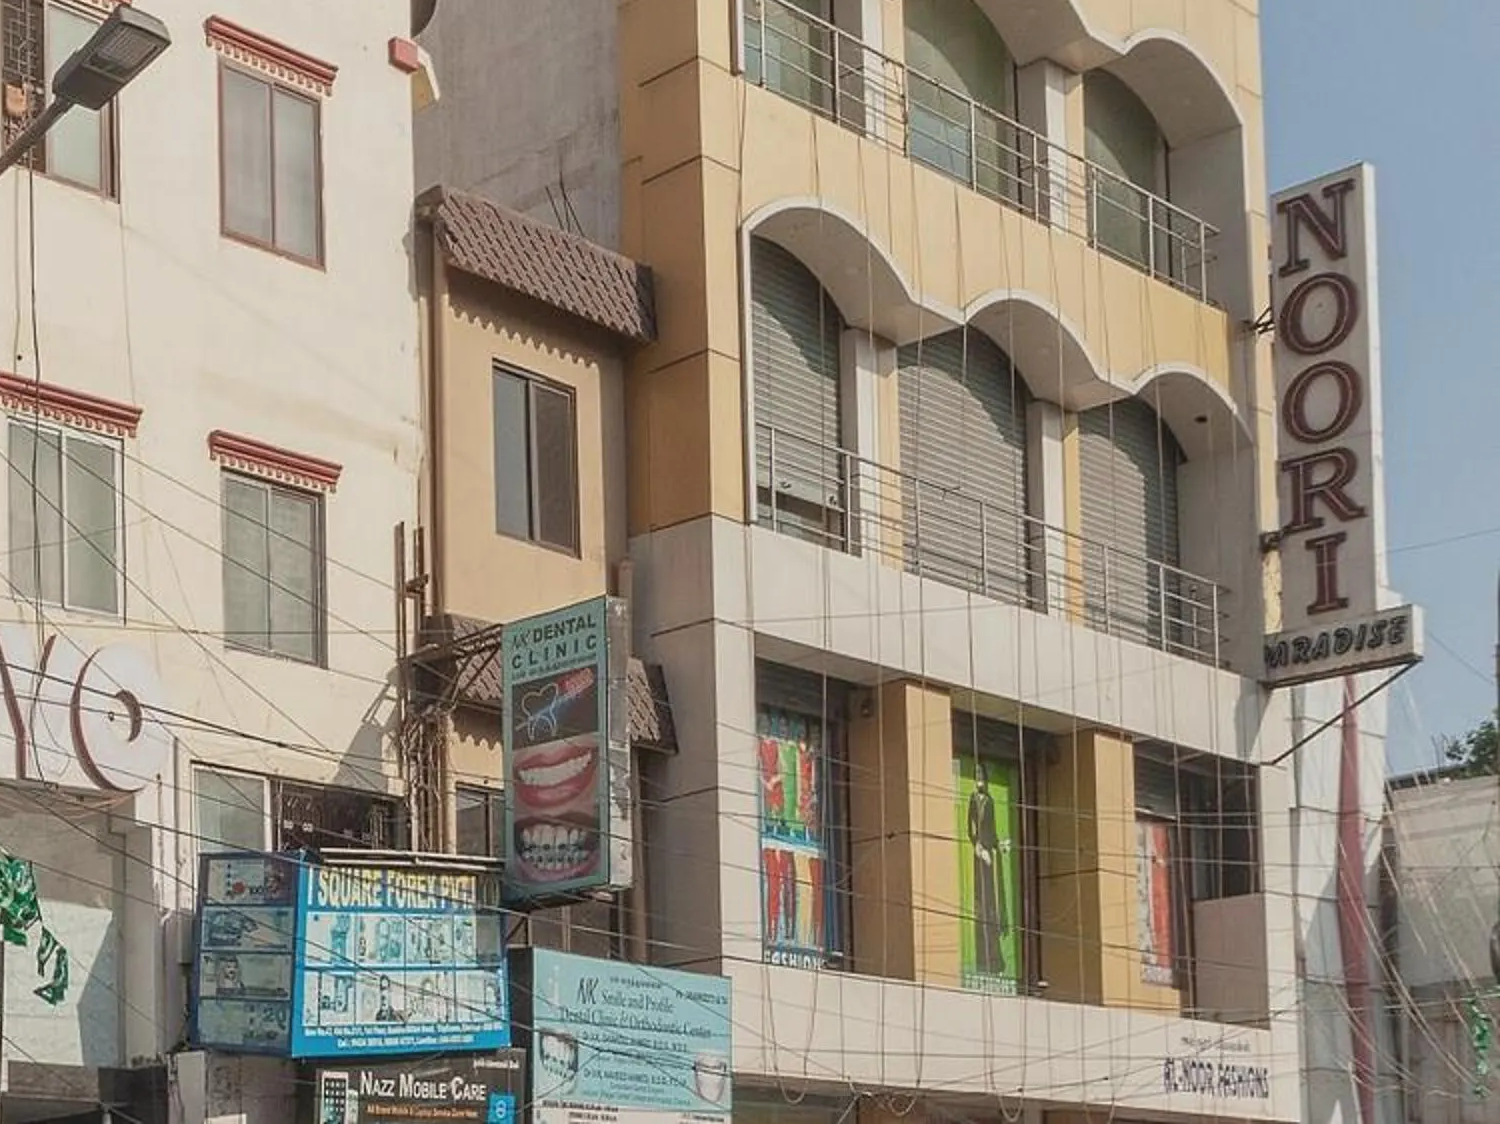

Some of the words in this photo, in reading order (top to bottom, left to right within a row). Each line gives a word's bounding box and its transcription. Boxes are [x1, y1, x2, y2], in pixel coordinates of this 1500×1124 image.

[1276, 178, 1369, 616] NOORI
[533, 612, 597, 644] DENTAL
[511, 634, 597, 670] CLINIC
[317, 866, 383, 908] SQUARE
[387, 869, 438, 910] FOREX
[576, 977, 599, 1005] NK
[359, 1070, 395, 1097] NAZZ
[399, 1073, 447, 1099] MOBILE
[451, 1075, 487, 1101] CARE
